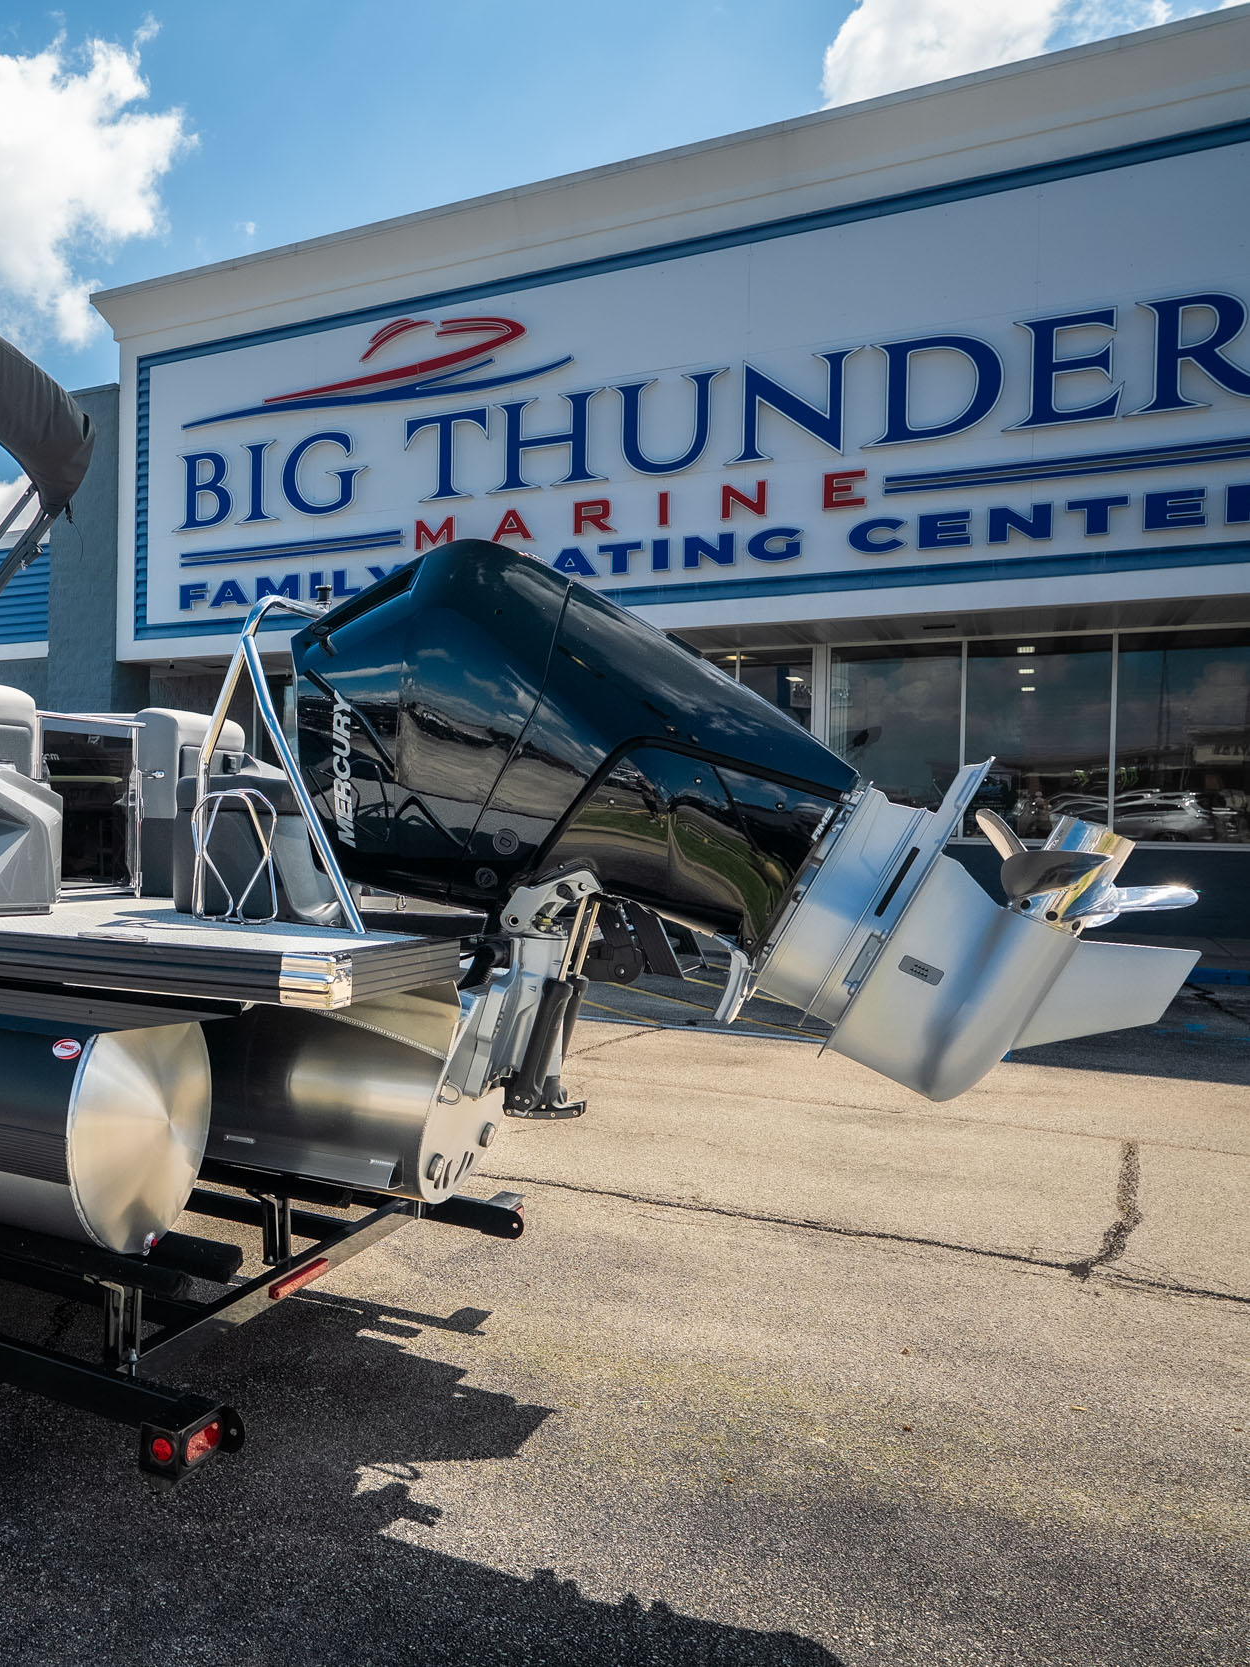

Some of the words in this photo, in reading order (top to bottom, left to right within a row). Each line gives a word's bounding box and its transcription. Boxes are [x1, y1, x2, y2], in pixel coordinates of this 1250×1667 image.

[173, 430, 369, 533] BIG
[404, 290, 1250, 503] THUNDER
[414, 468, 868, 551] MARINE
[551, 526, 805, 578] ATING
[333, 689, 357, 849] MERCURY
